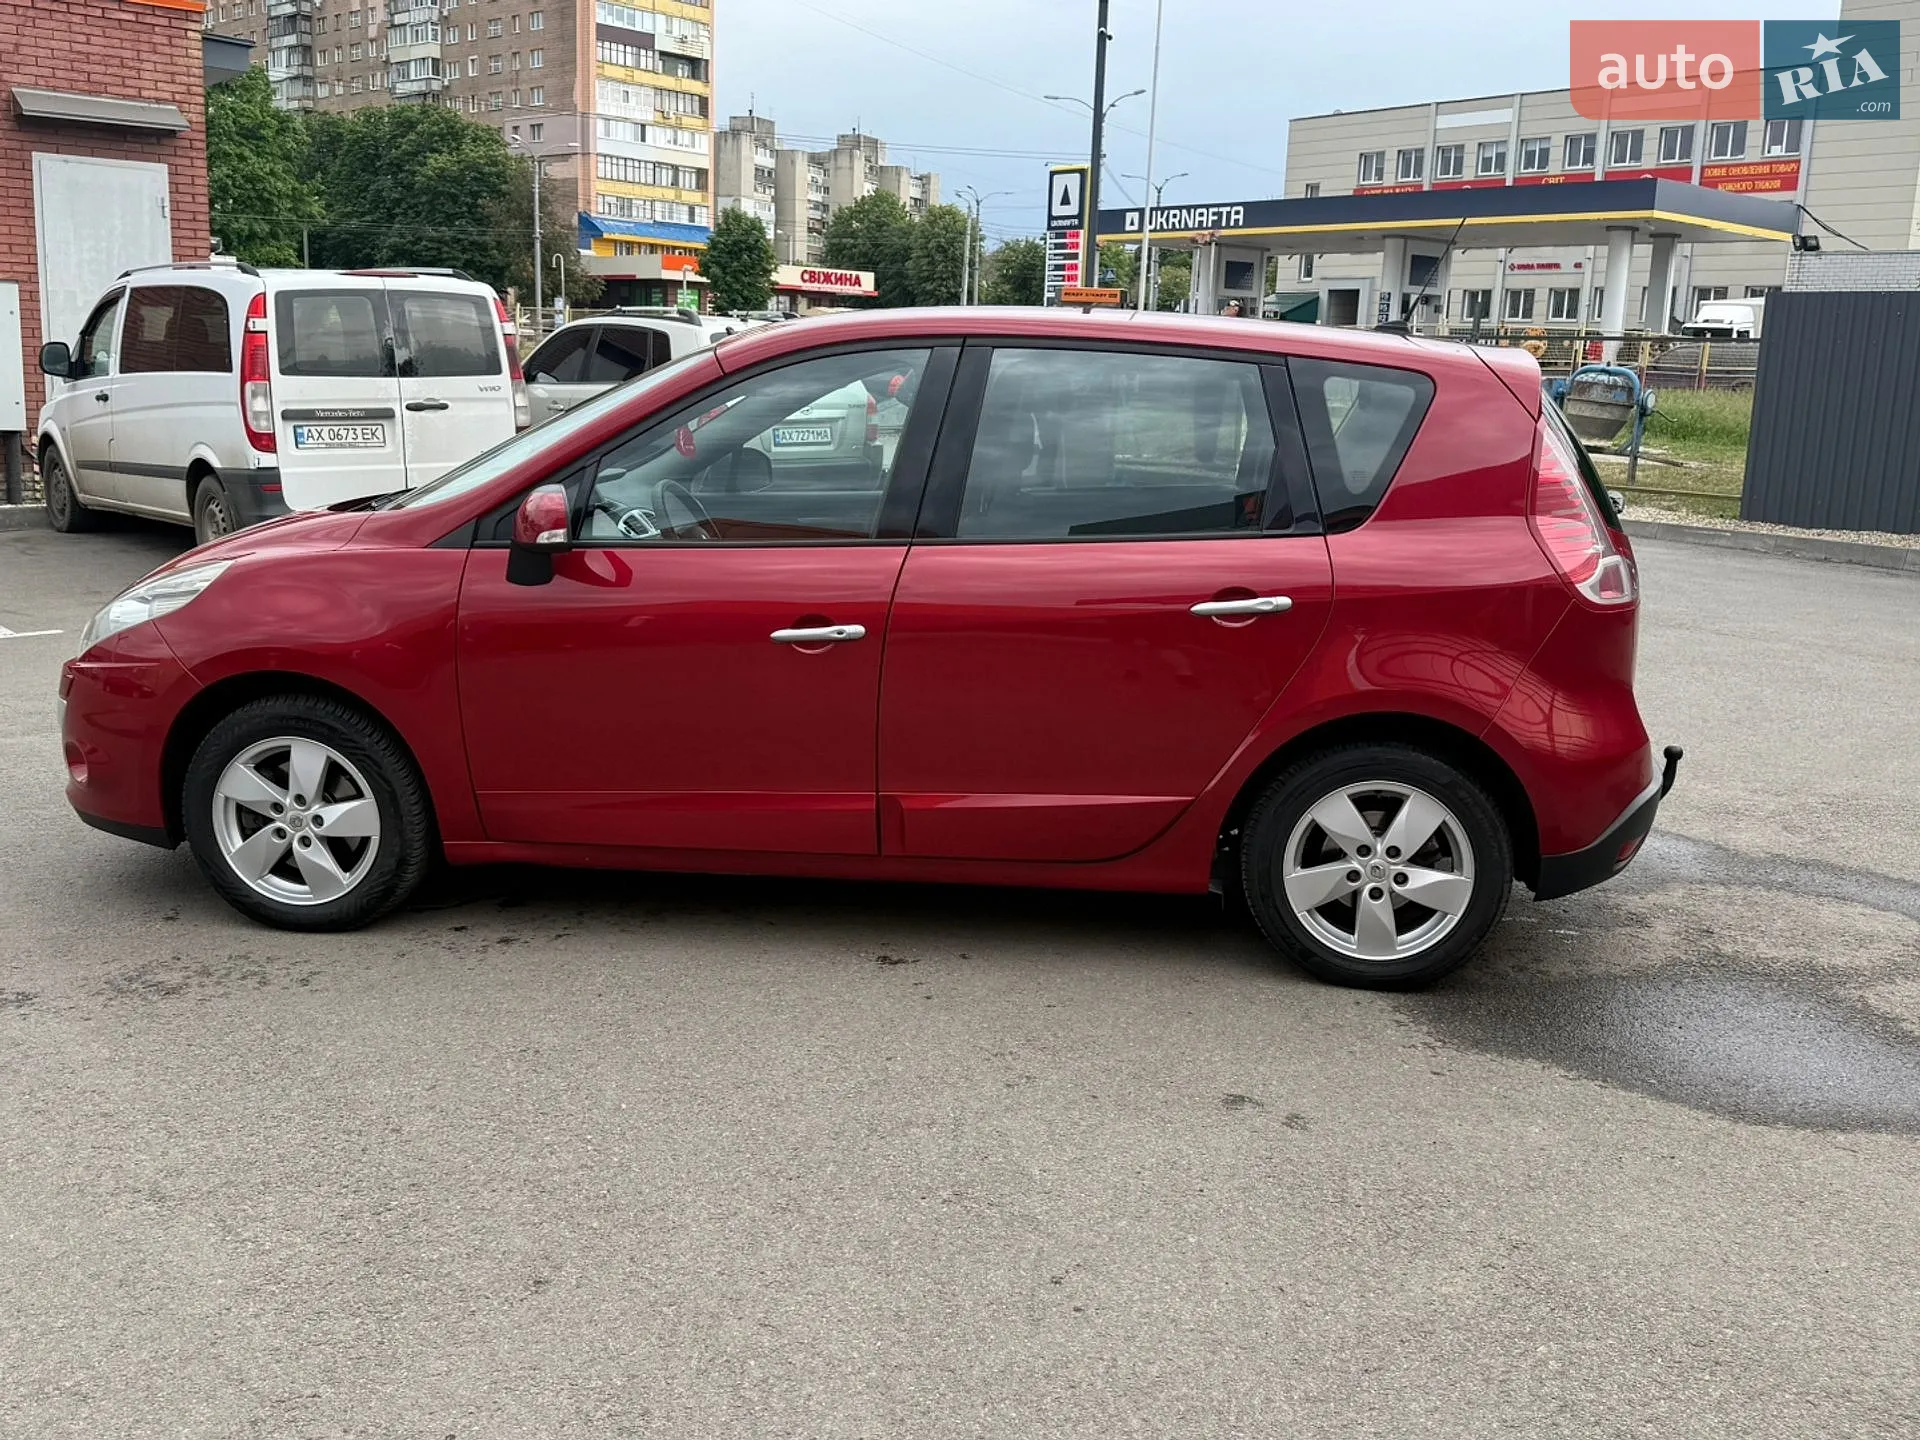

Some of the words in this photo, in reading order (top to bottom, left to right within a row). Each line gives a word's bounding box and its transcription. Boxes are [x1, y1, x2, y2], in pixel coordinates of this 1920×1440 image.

[1147, 205, 1244, 230] UKRNAFTA
[800, 269, 862, 287] СВІЖИНА
[306, 427, 325, 441] AX
[328, 426, 358, 441] 0673
[362, 426, 380, 441] EK
